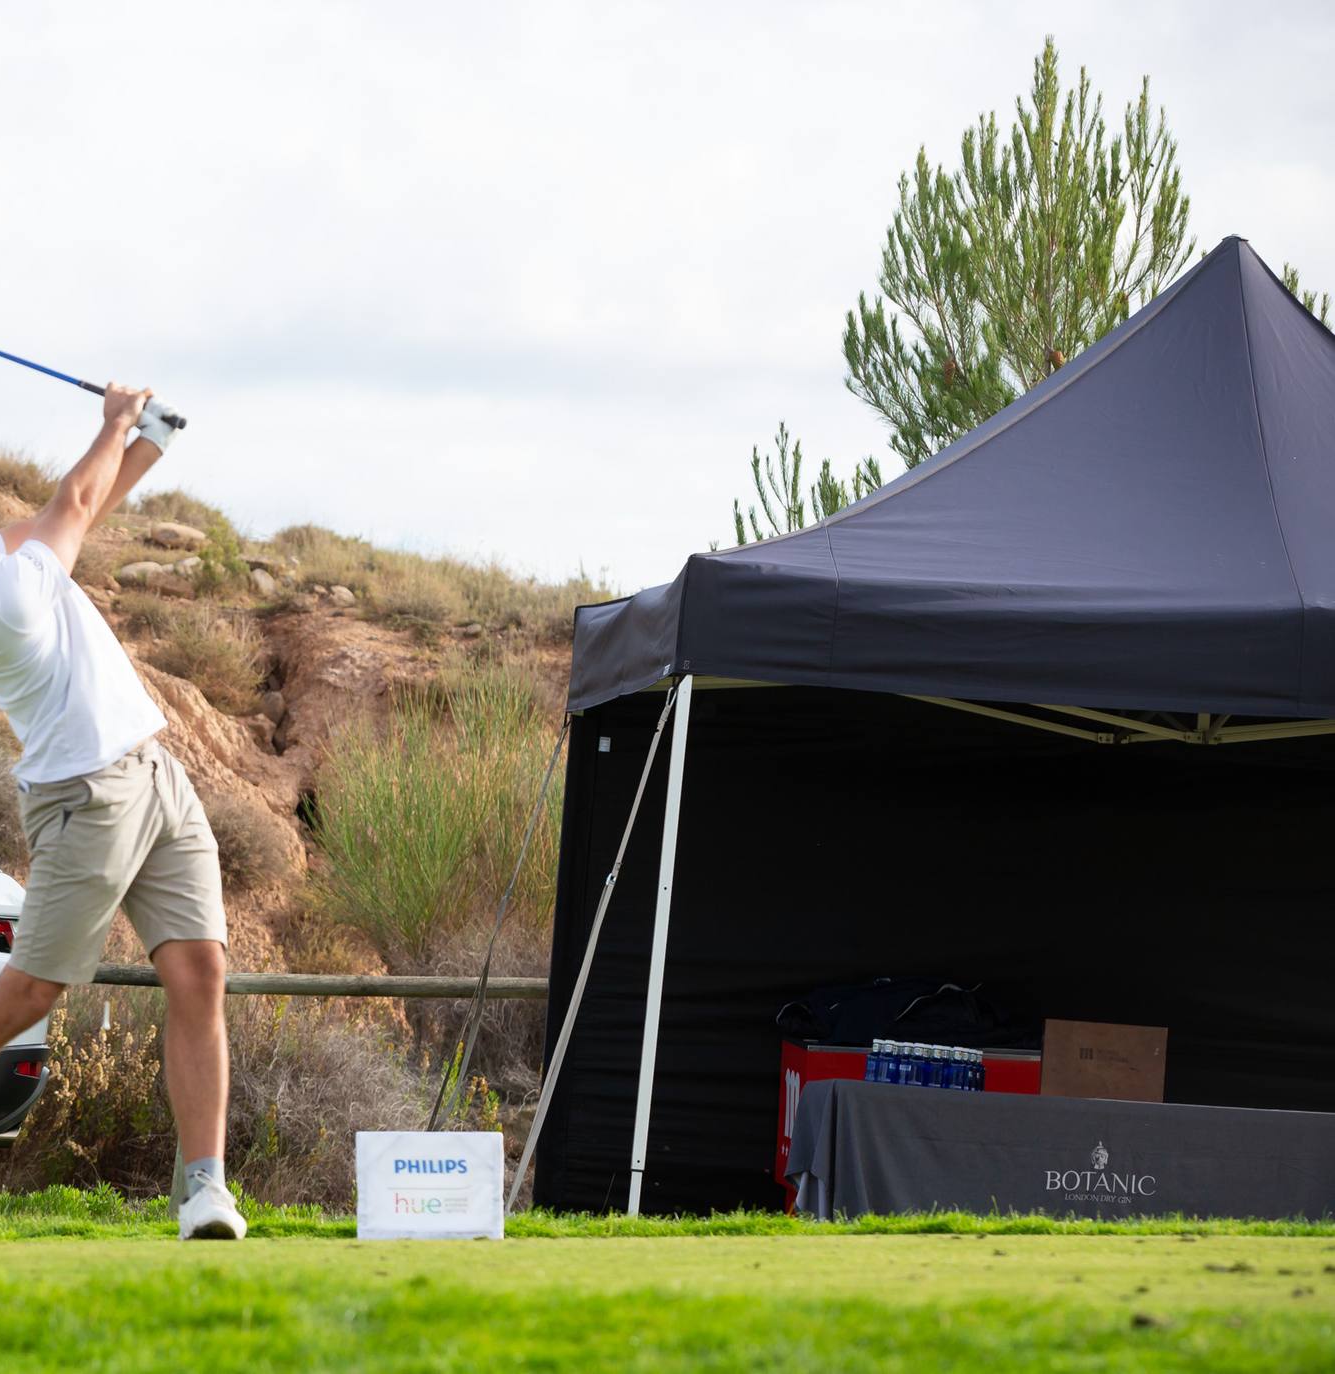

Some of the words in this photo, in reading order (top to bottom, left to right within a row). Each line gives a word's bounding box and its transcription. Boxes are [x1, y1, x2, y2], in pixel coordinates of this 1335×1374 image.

[394, 1159, 468, 1174] PHILIPS
[1044, 1170, 1156, 1196] BOTANIC
[394, 1192, 442, 1214] hue
[1065, 1193, 1099, 1202] LONDON
[1118, 1196, 1132, 1204] GIN
